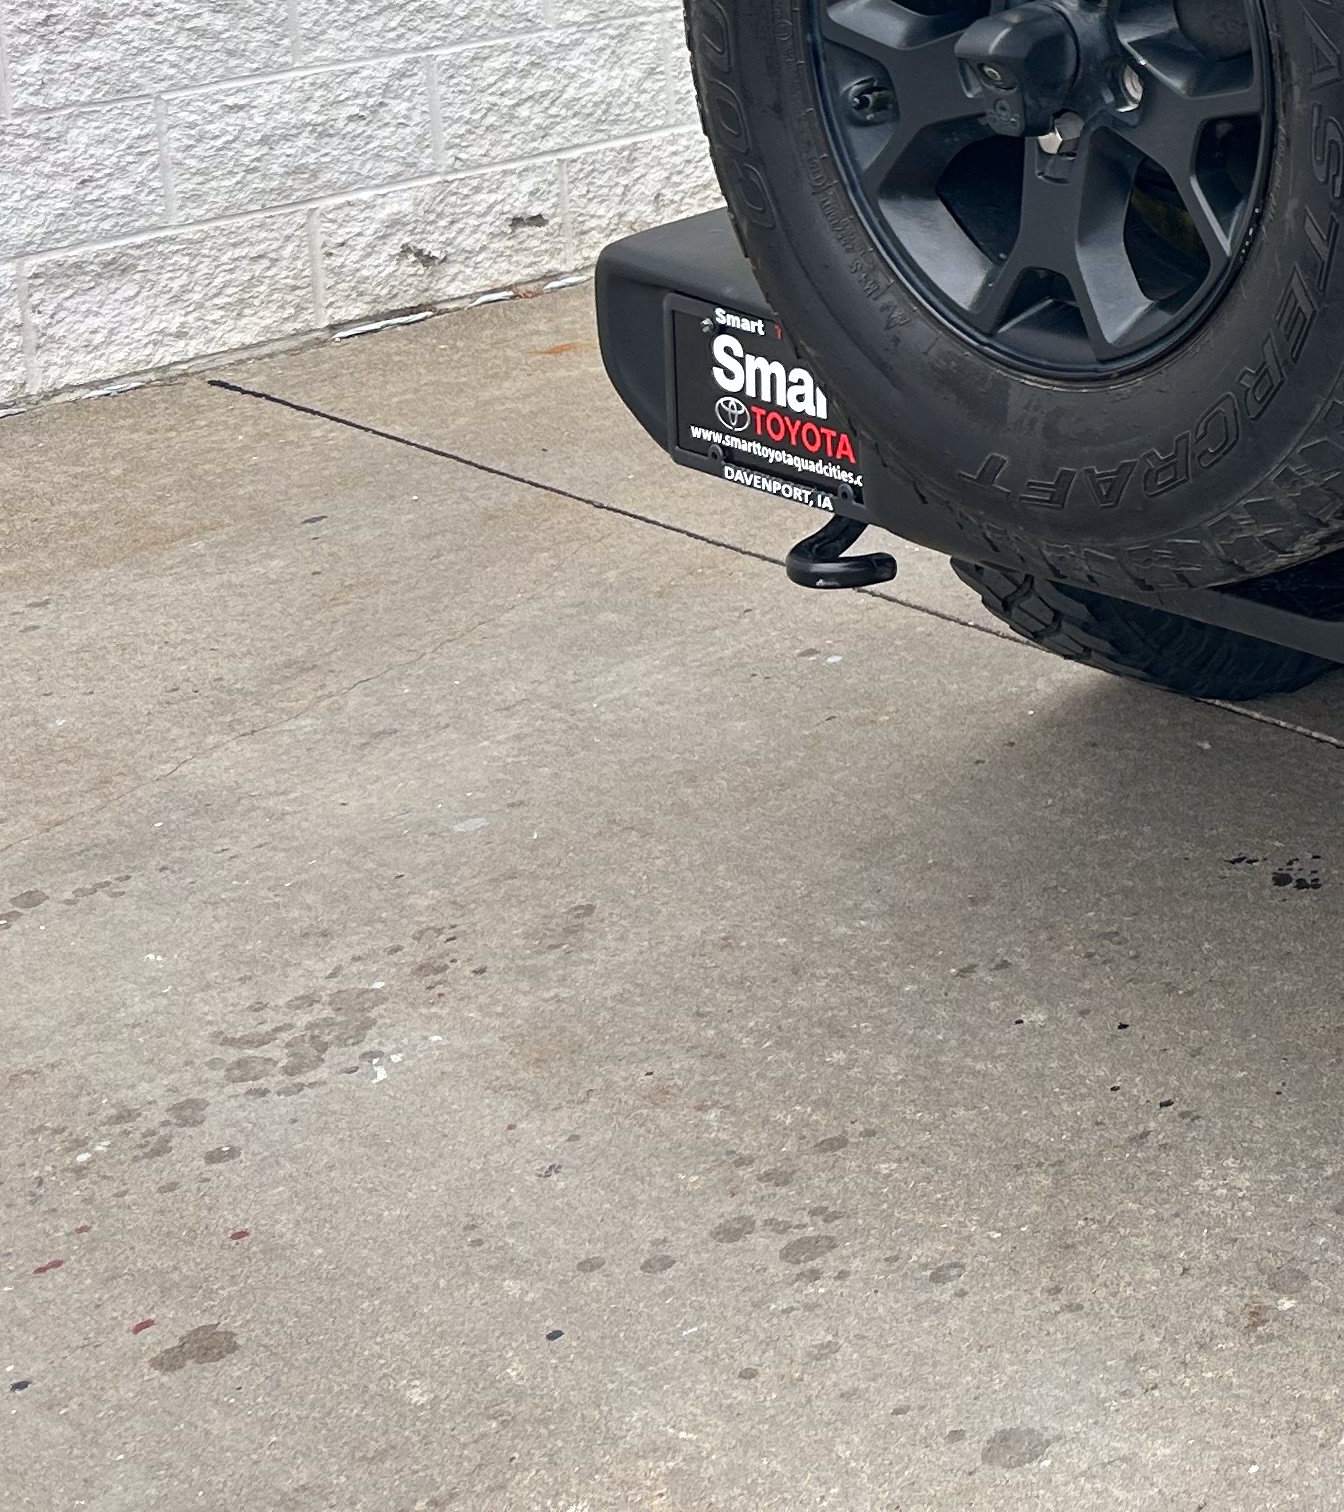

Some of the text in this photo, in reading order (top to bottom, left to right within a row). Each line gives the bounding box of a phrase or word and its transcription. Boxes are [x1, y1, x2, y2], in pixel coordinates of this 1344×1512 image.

[715, 308, 765, 336] Smart
[751, 406, 857, 464] TOYOTA
[724, 465, 834, 510] DAVENPORT, IA
